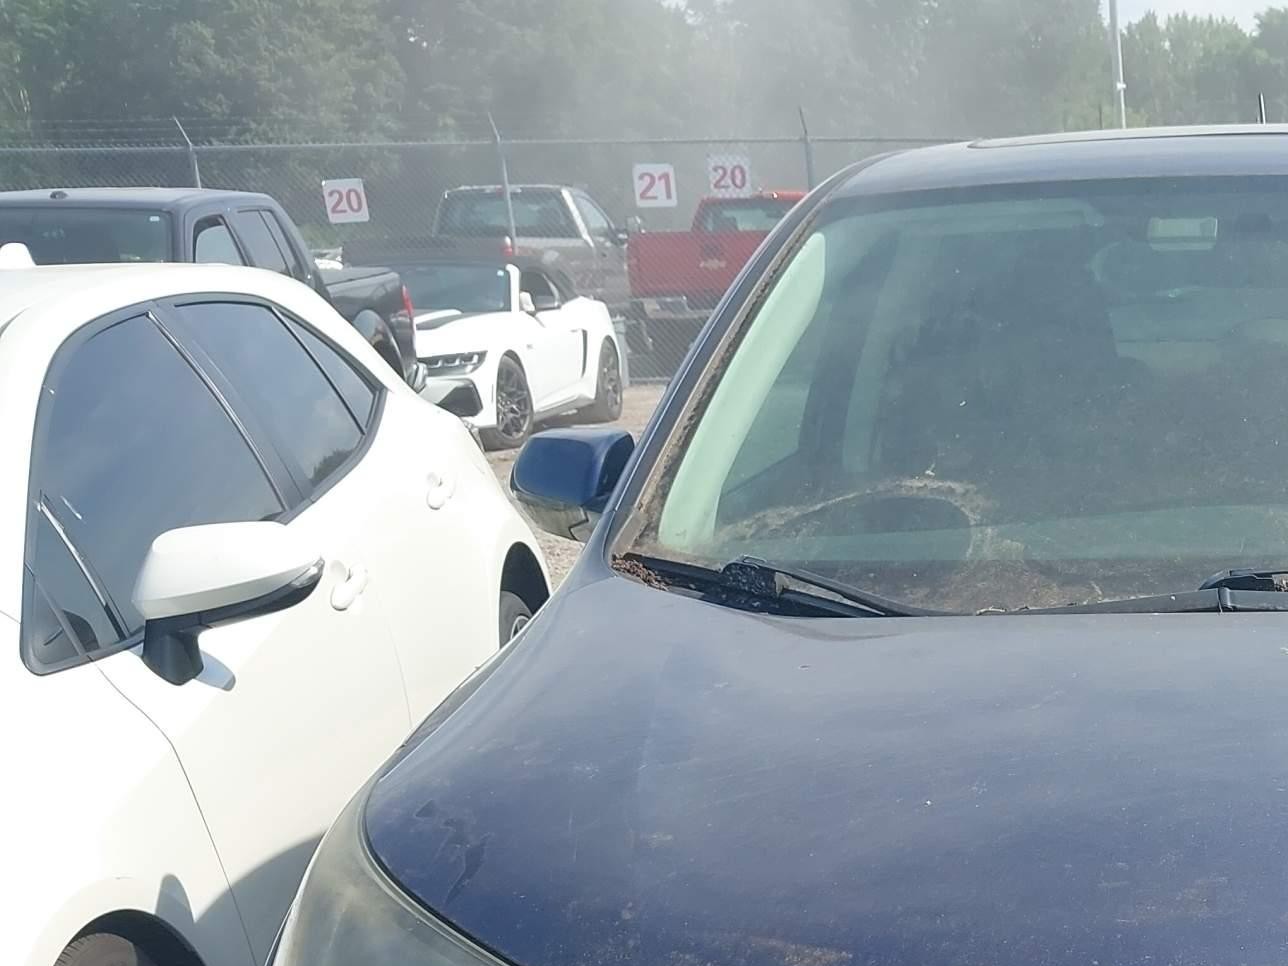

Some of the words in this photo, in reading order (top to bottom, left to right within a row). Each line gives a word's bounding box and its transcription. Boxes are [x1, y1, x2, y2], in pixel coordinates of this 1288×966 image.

[638, 171, 673, 200] 21
[711, 165, 746, 190] 20
[328, 188, 363, 214] 20
